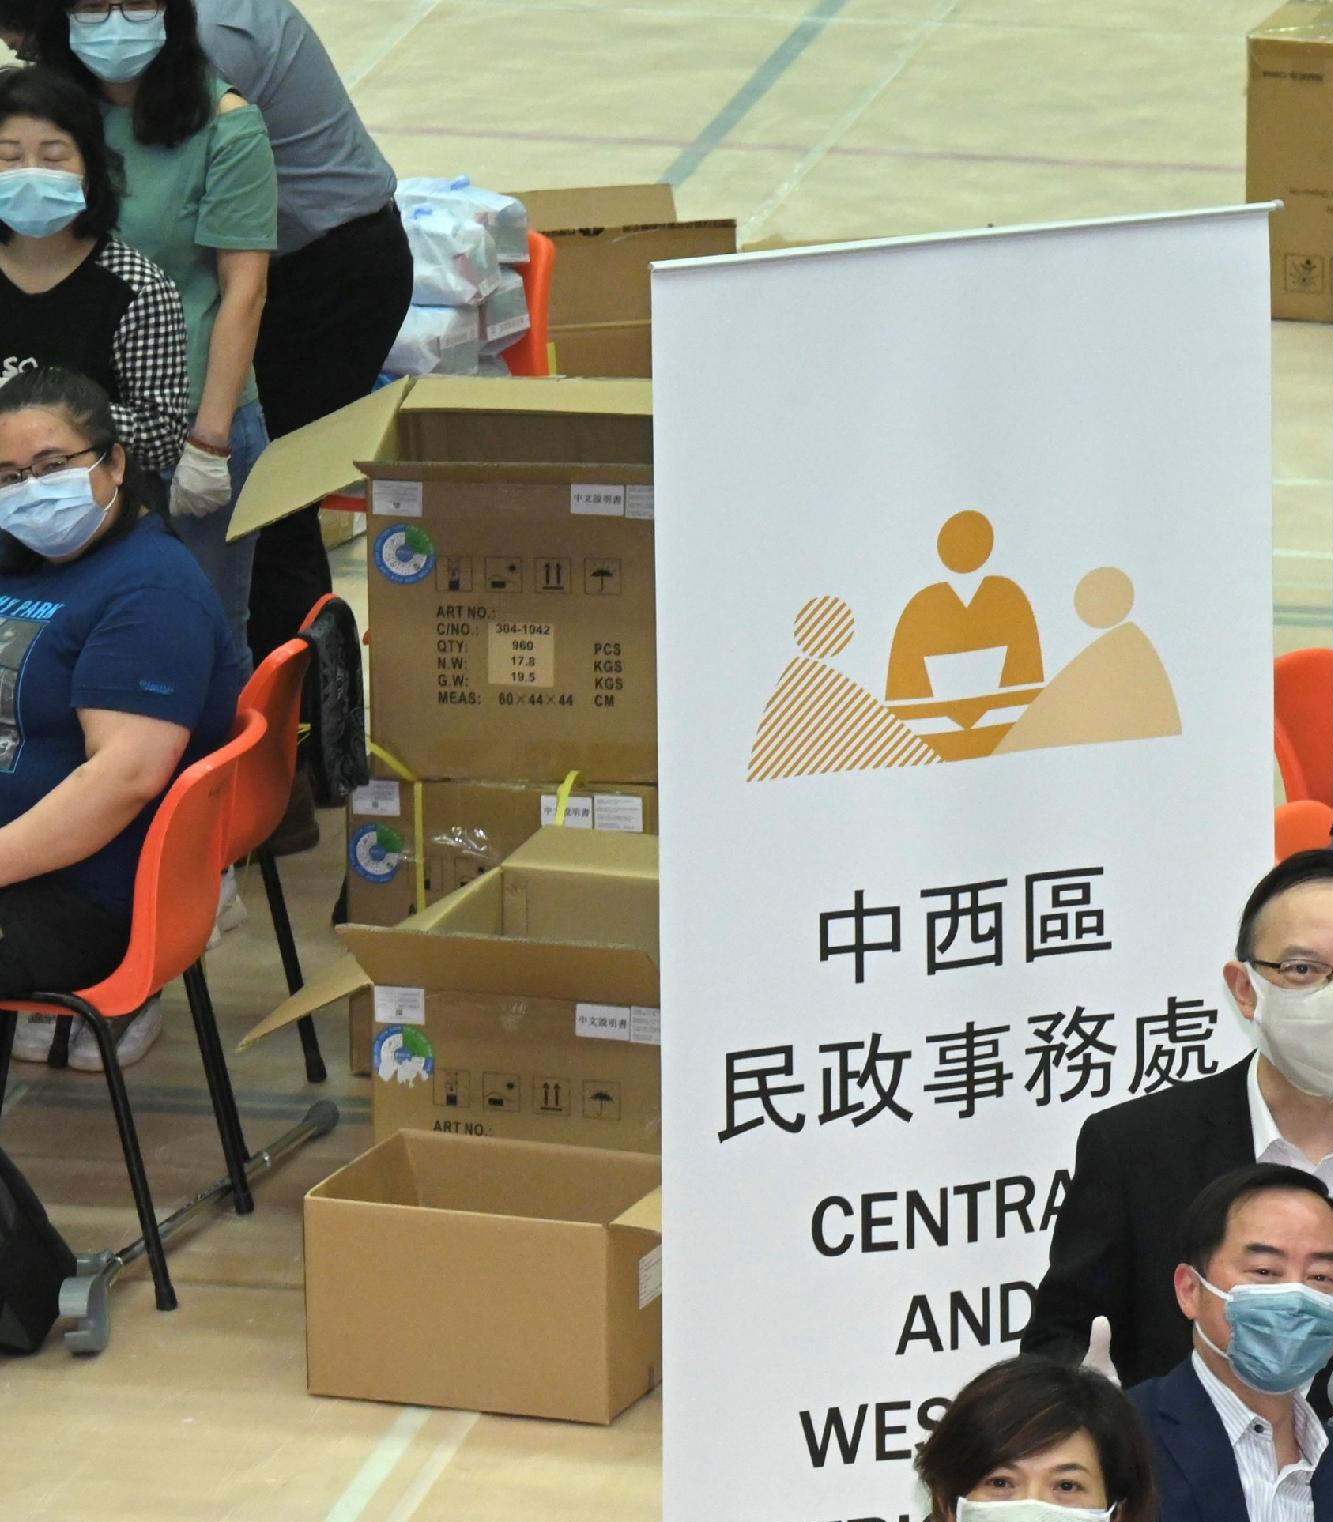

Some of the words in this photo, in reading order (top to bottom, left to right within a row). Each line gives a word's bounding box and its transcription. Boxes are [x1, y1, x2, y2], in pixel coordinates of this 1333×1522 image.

[436, 606, 463, 619] ART
[495, 623, 551, 635] 304-1042
[436, 640, 469, 654] QTY:
[511, 640, 535, 651] 960
[593, 643, 622, 656] PCS
[510, 656, 536, 667] 17.8
[593, 660, 623, 673] KGS
[510, 671, 536, 683] 19.5
[594, 677, 624, 690] KGS
[438, 692, 482, 706] MEAS:
[593, 694, 615, 707] CM
[818, 865, 1113, 986] 中西區
[717, 996, 1220, 1144] 民政事務處
[811, 1169, 1076, 1258] CENTRA
